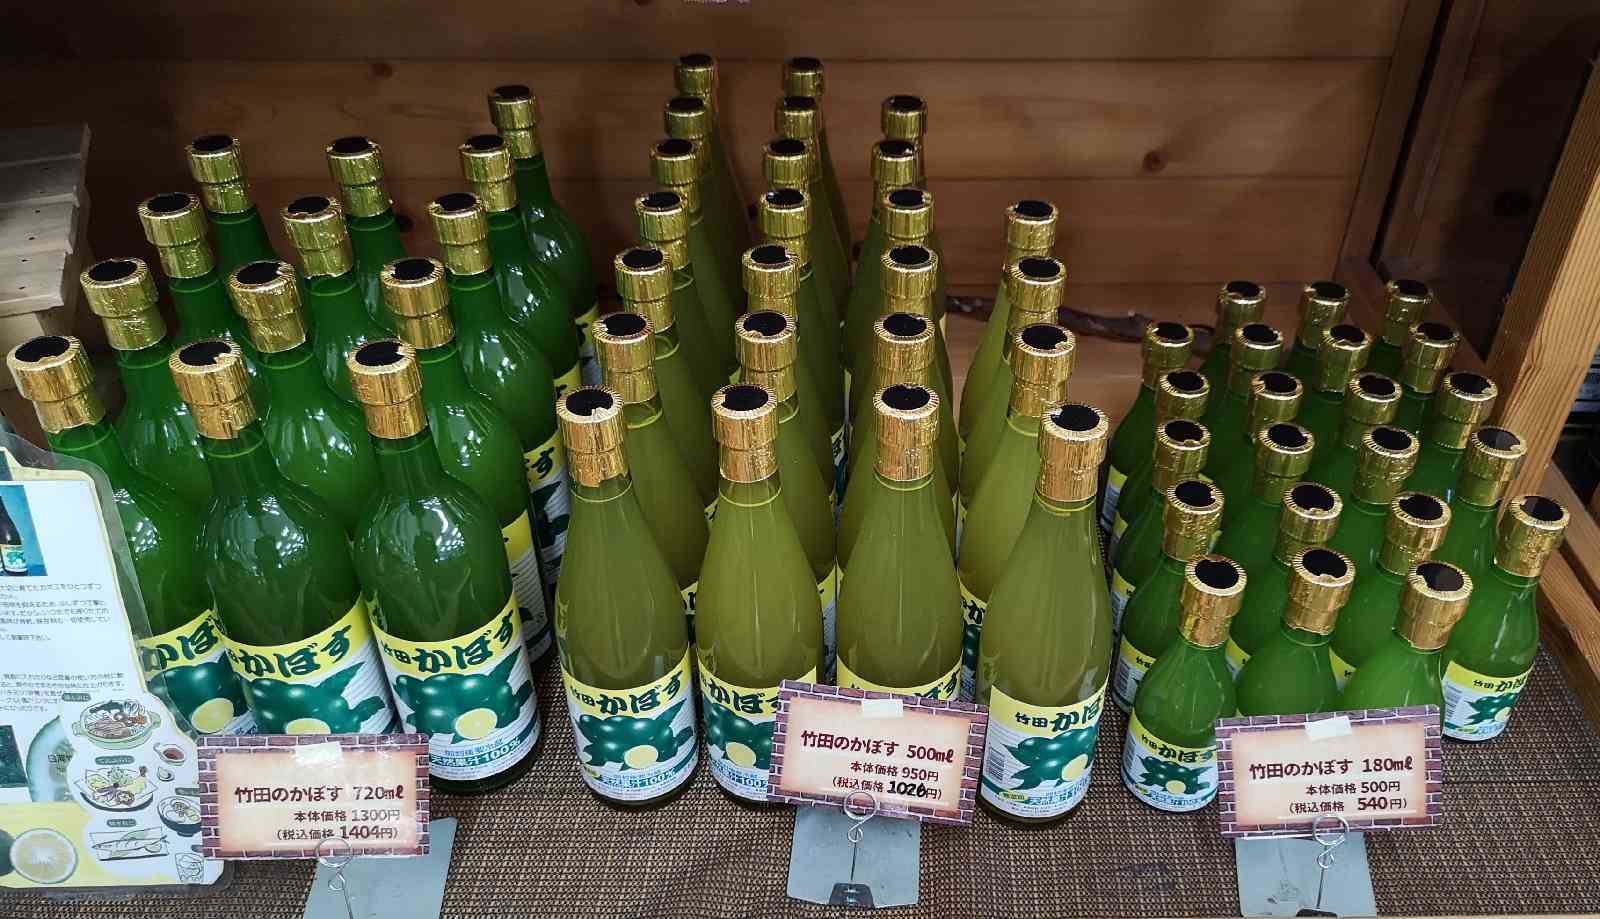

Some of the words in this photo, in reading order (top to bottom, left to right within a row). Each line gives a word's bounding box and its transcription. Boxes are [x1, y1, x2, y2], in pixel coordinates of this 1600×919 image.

[800, 730, 900, 757] 竹田のかぼす
[850, 760, 898, 777] 本体価格
[901, 766, 939, 782] 950円
[1249, 759, 1353, 780] 竹田のかぼす
[234, 786, 343, 803] 竹田のかぼす
[1305, 783, 1357, 796] 本体価格
[1360, 780, 1401, 793] 500円
[293, 810, 347, 823] 本体価格
[351, 808, 401, 821] 1300円
